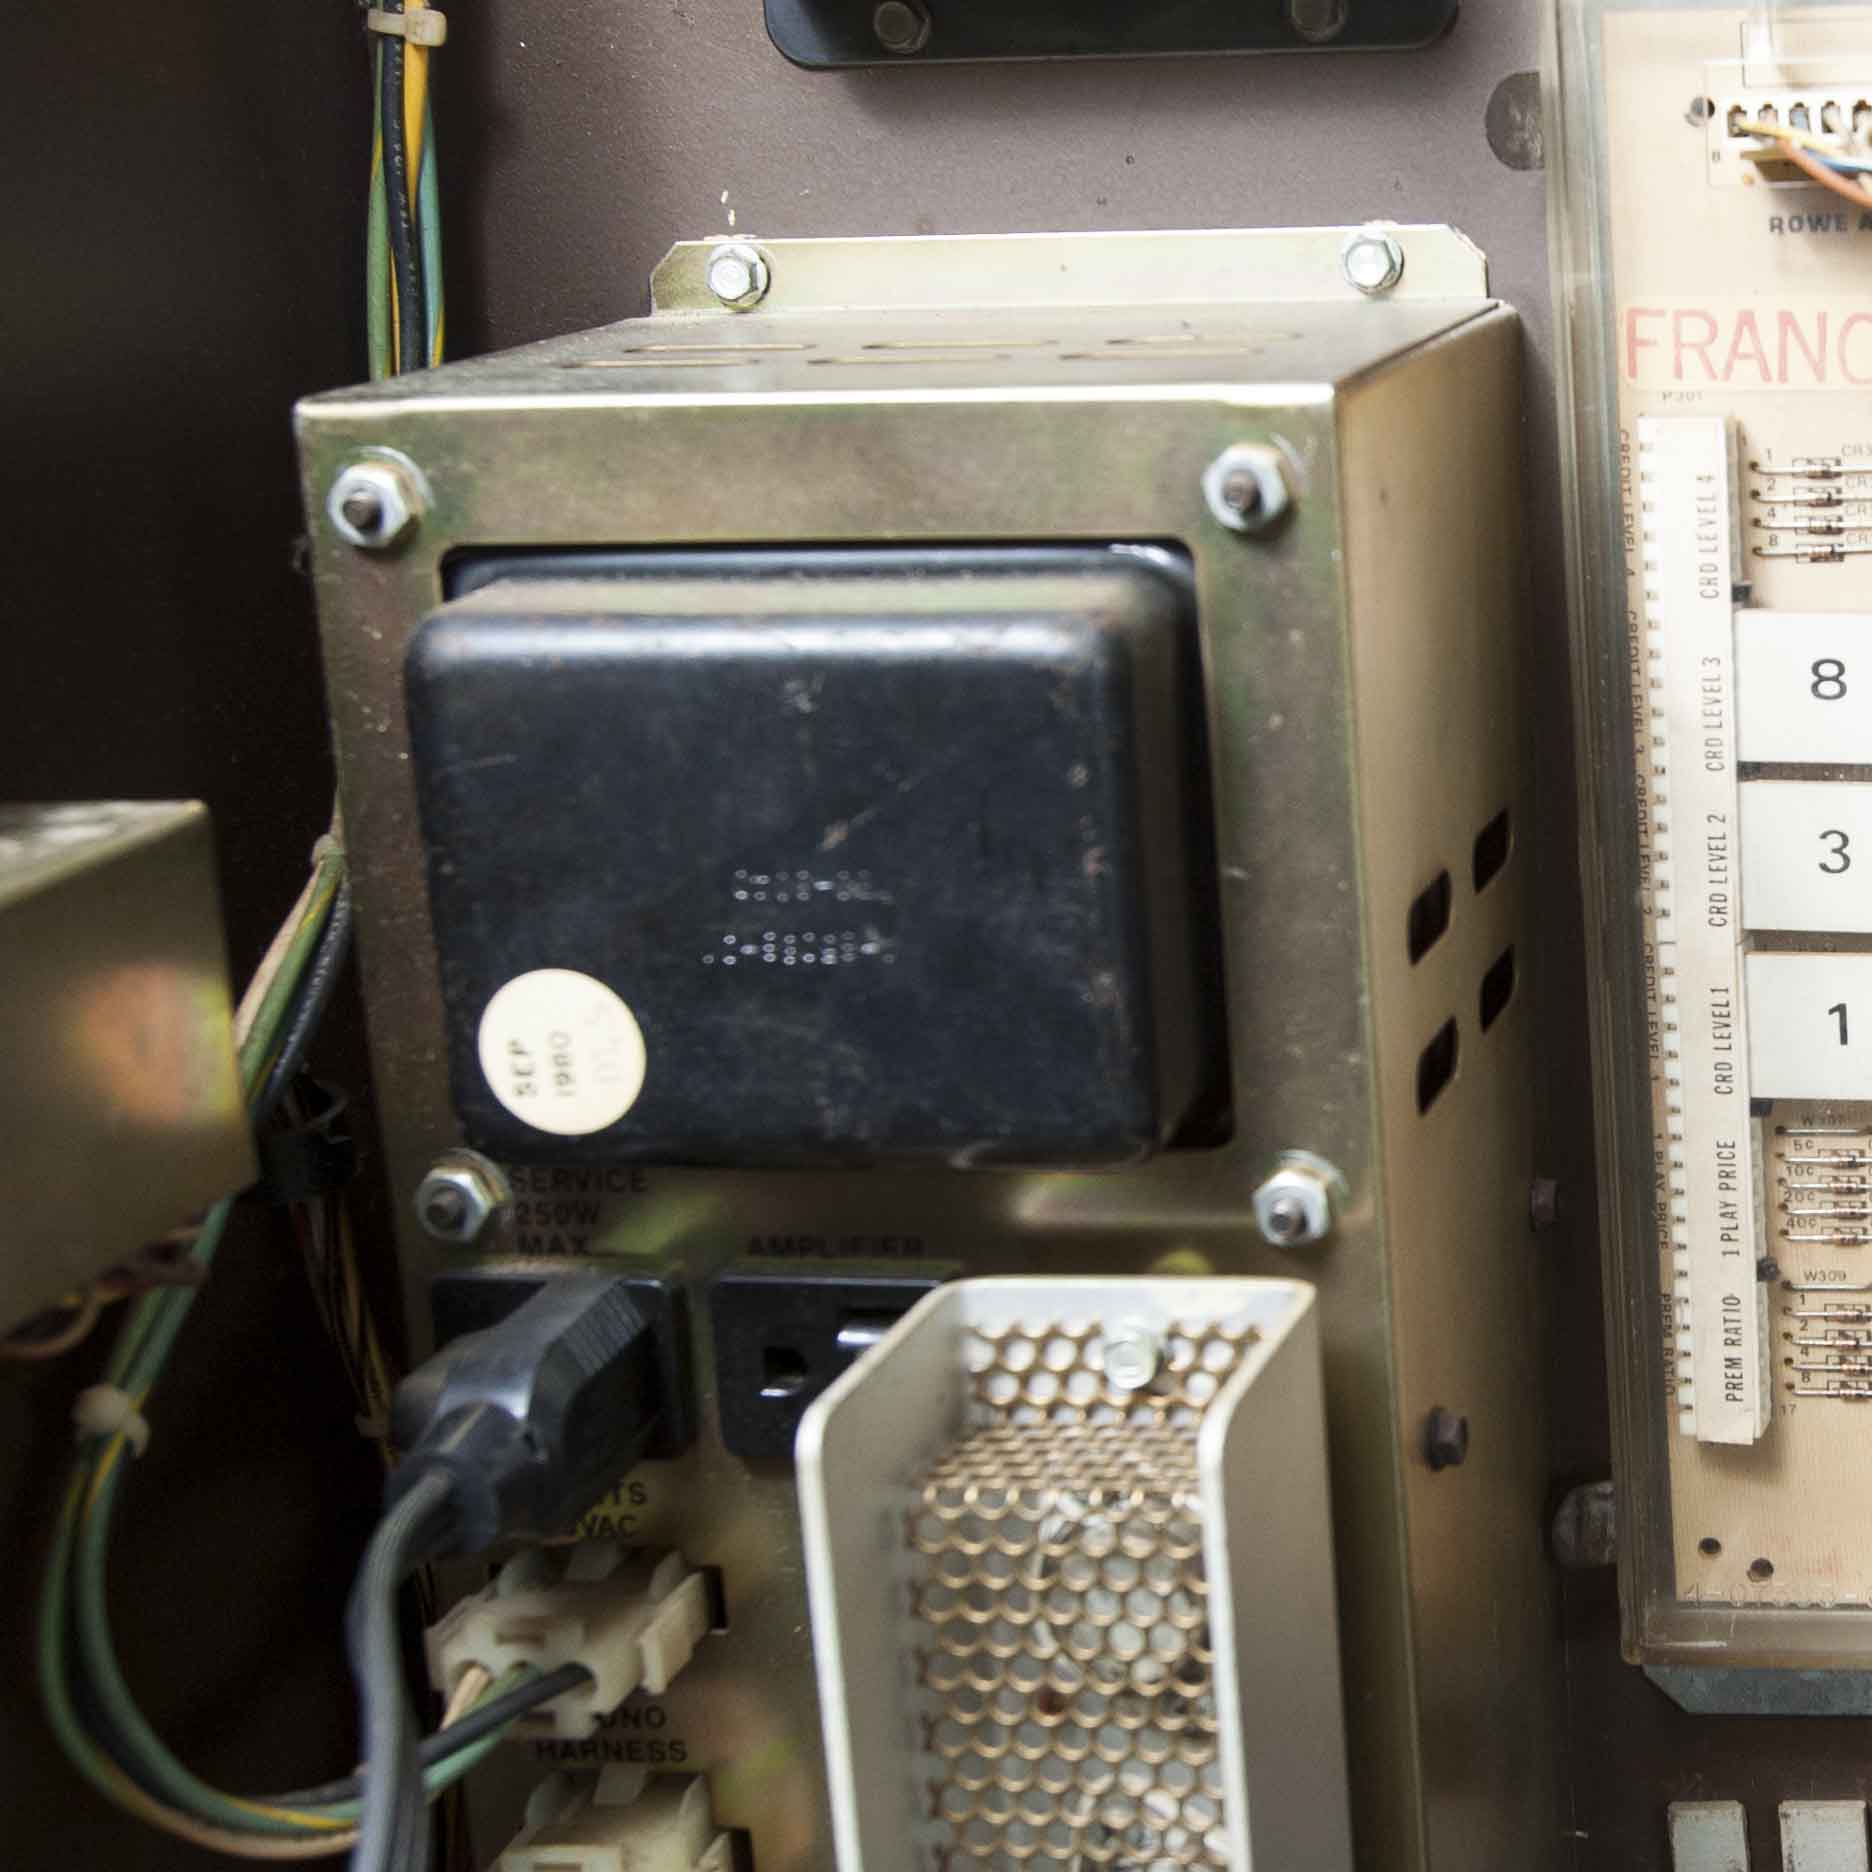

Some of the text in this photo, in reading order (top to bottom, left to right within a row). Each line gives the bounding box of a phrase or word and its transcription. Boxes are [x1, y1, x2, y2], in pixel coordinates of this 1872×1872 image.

[1769, 215, 1848, 234] ROWE
[1696, 495, 1718, 554] LEVEL
[1702, 672, 1722, 728] LEVEL
[1811, 659, 1847, 700] 8
[1704, 734, 1725, 772] CRD
[1708, 813, 1728, 928] CRD LEVEL 2
[1819, 830, 1850, 873] 3
[1713, 999, 1732, 1051] LEVEL
[1827, 1003, 1849, 1046] 1
[1714, 1057, 1734, 1096] CRD
[1716, 1140, 1737, 1191] PRICE
[1719, 1201, 1739, 1242] PLAY
[519, 1236, 592, 1257] MAX
[1804, 1270, 1847, 1281] W309
[1723, 1295, 1744, 1403] PREM RATIO
[537, 1740, 687, 1763] HARNESS
